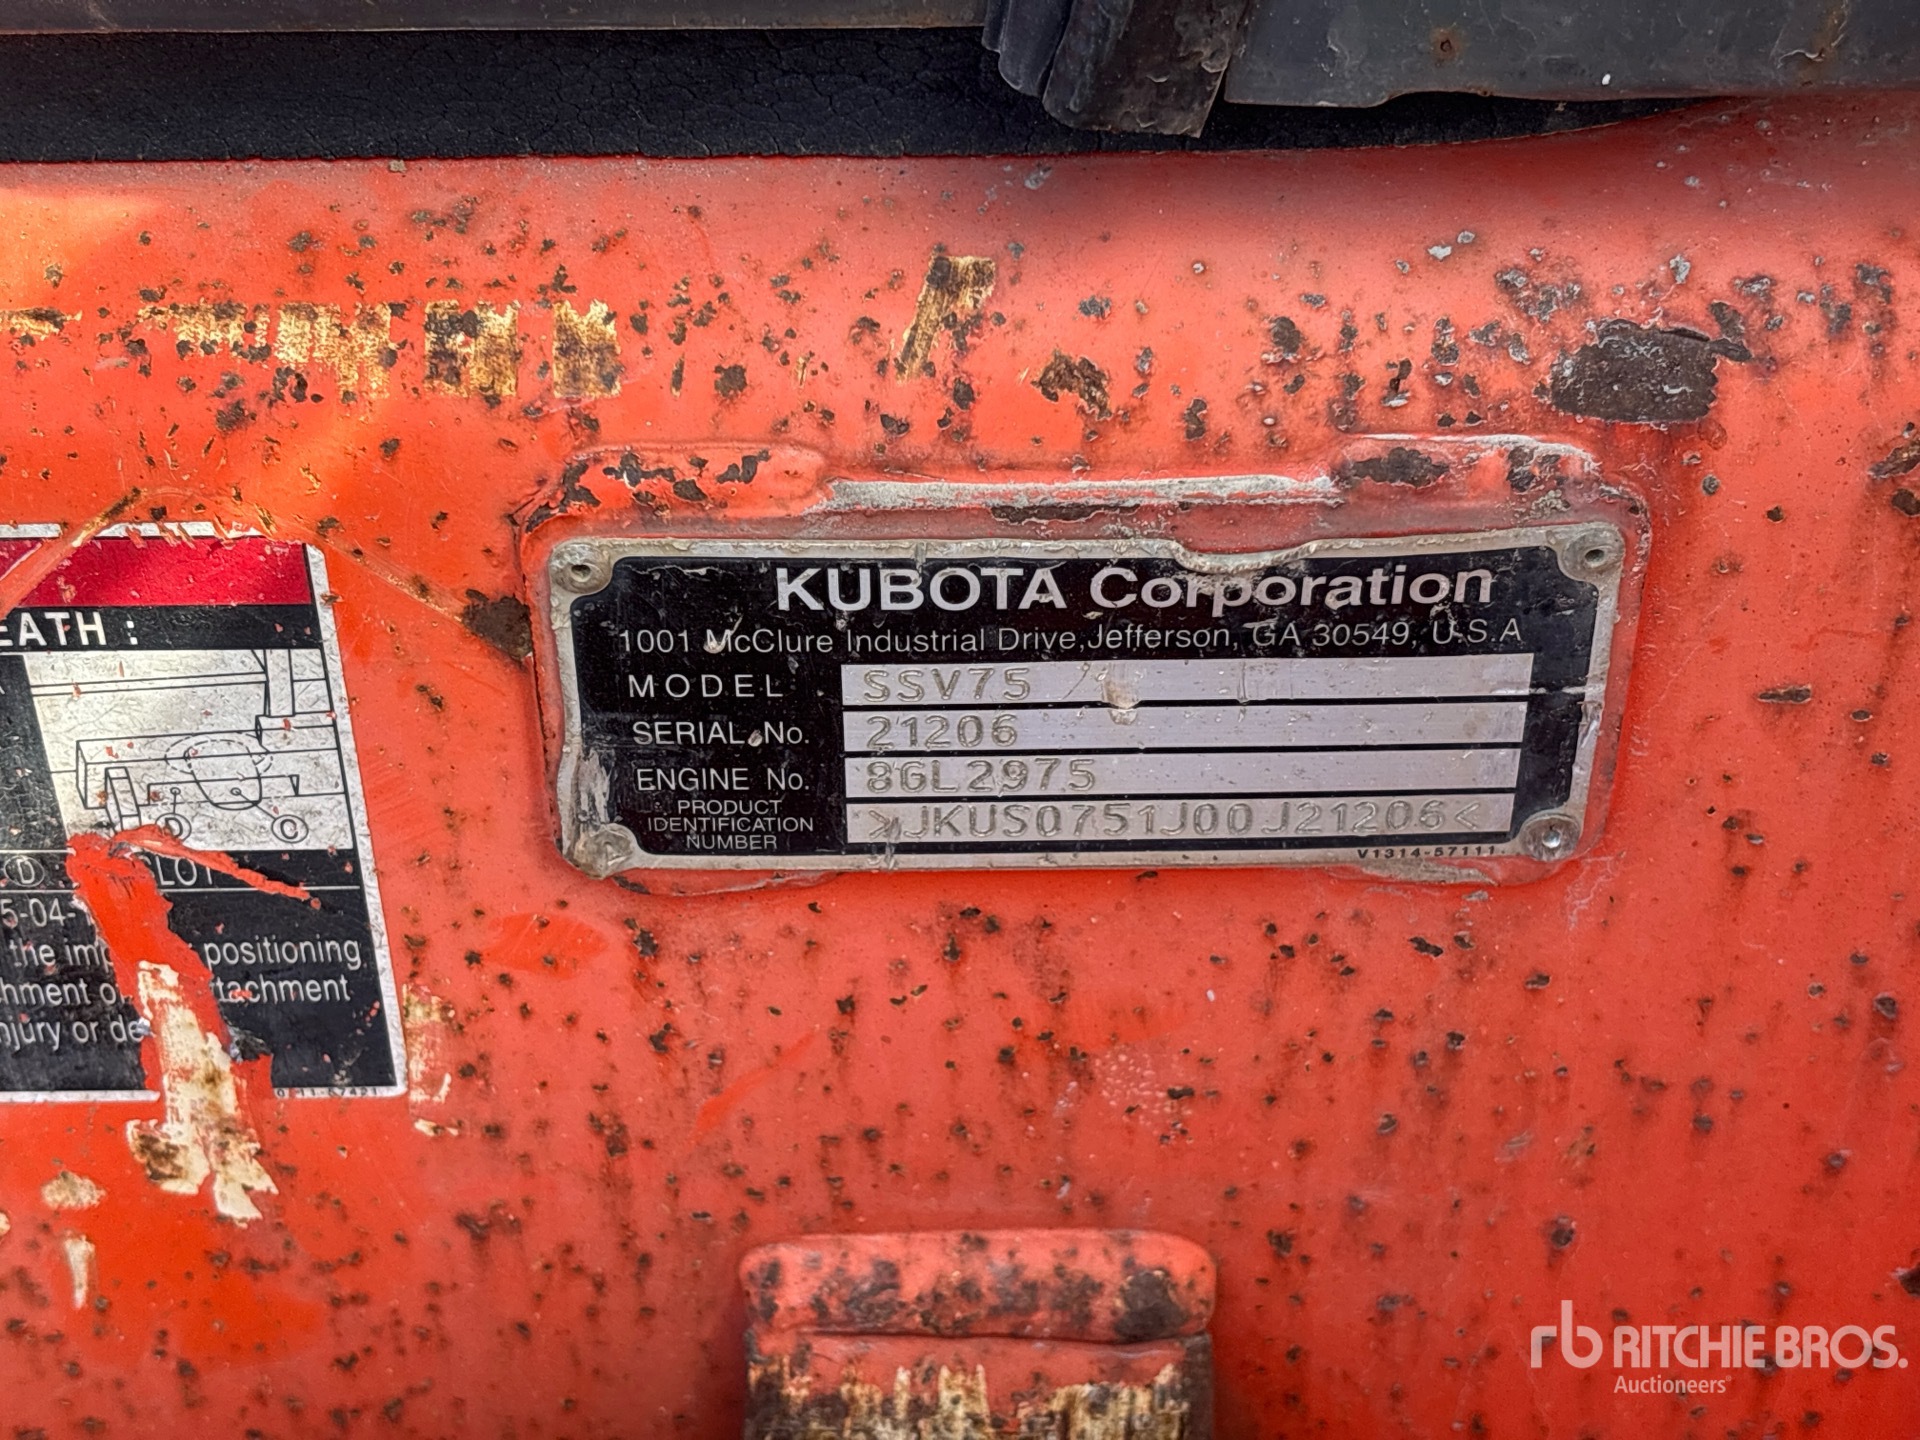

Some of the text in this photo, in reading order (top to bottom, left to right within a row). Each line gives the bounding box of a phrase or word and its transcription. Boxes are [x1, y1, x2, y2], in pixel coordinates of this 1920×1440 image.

[775, 565, 1492, 618] KUBOTA Corporation
[619, 629, 690, 653] 1001
[704, 627, 833, 653] McClure
[847, 628, 985, 652] Industrial
[1252, 622, 1300, 647] GA
[1312, 621, 1417, 648] 30549,
[628, 674, 783, 698] MODEL
[863, 668, 1030, 702] SSV75
[633, 722, 810, 745] SERIAL No.
[866, 714, 1018, 750] 21206
[636, 769, 810, 791] ENGINE No.
[866, 757, 1096, 794] 8GL2975
[677, 800, 782, 816] PRODUCT
[647, 817, 814, 833] IDENTIFICATION
[686, 834, 777, 850] NUMBER
[10, 937, 57, 967] the
[203, 934, 362, 970] positioning
[72, 1019, 99, 1044] or
